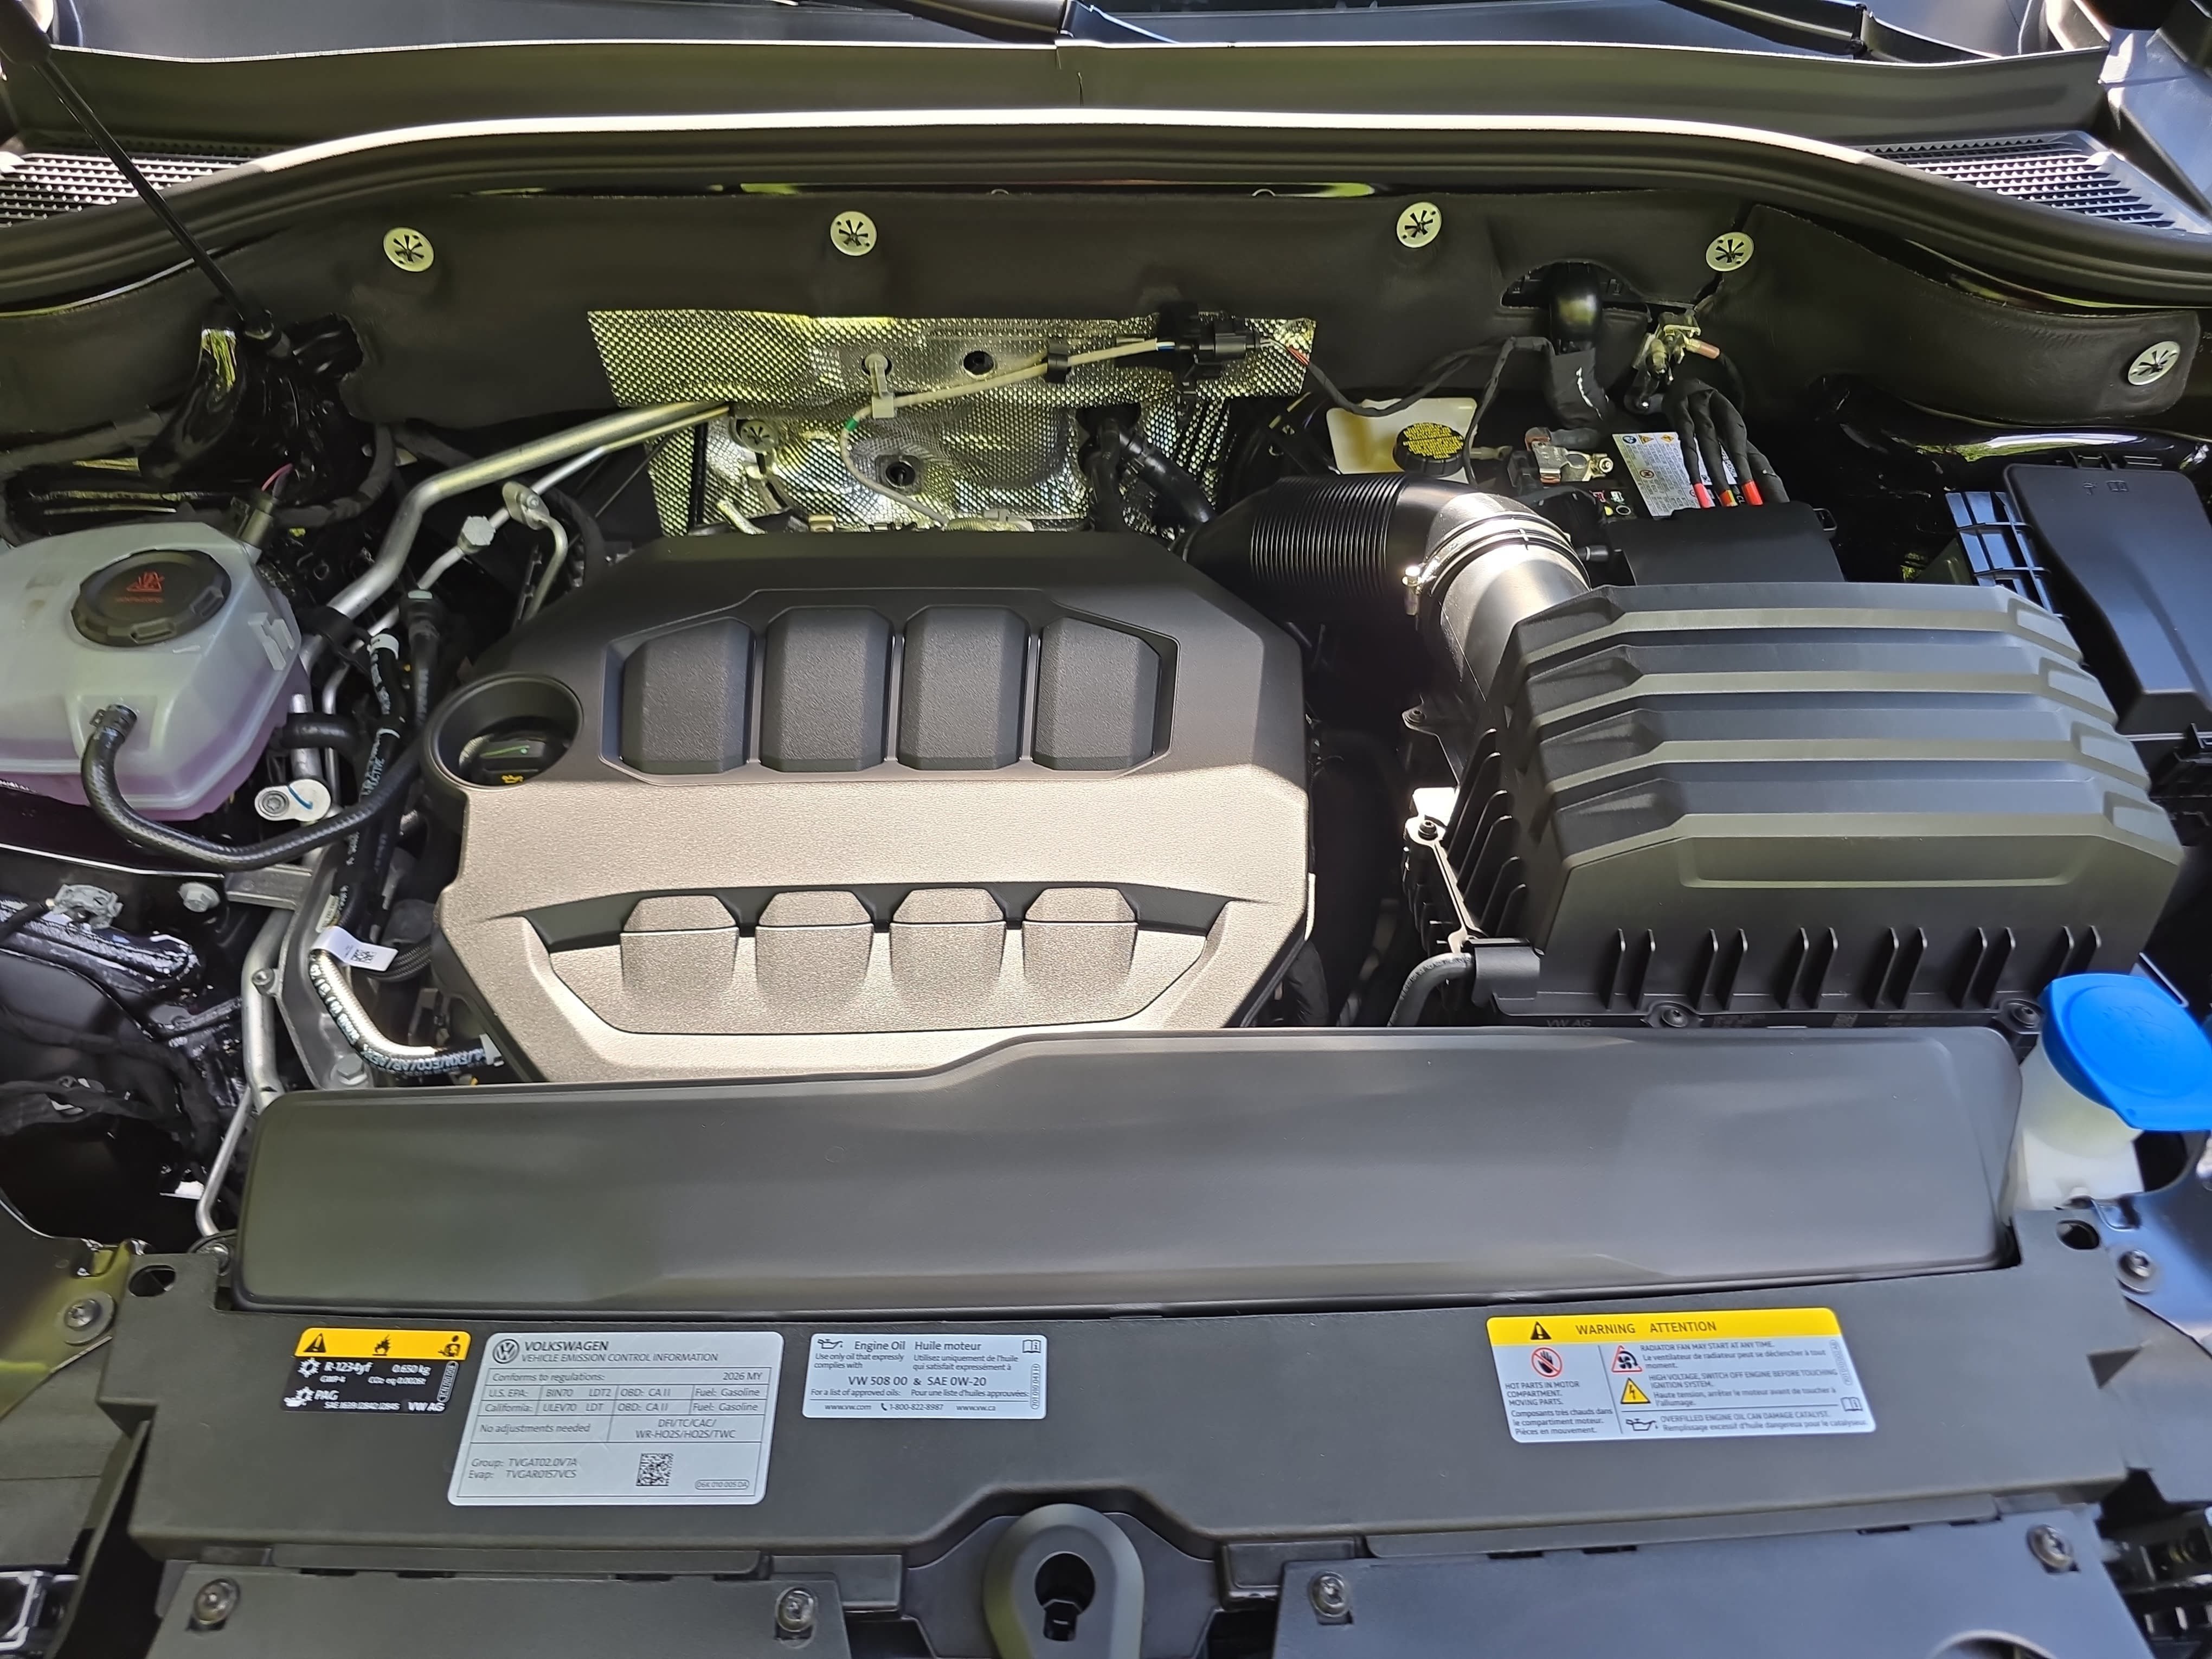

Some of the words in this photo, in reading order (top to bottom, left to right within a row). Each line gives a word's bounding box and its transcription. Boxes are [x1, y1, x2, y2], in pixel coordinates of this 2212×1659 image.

[1576, 1324, 1636, 1335] WARNING
[1650, 1321, 1717, 1333] ATTENTION
[524, 1341, 609, 1351] VOLKSWAGEN
[854, 1341, 889, 1352] Engine
[891, 1341, 906, 1350] Oil
[915, 1341, 942, 1350] Huile
[522, 1354, 559, 1362] VEHICLE
[561, 1354, 605, 1362] EMISSION
[607, 1353, 651, 1361] CONTROL
[653, 1353, 718, 1361] INFORMATION
[829, 1353, 844, 1361] only
[872, 1353, 904, 1362] expressly
[941, 1355, 985, 1363] uniquement
[956, 1363, 1005, 1371] expressément
[492, 1373, 537, 1381] Conforms
[551, 1372, 605, 1383] regulations:
[722, 1372, 744, 1380] 2026
[848, 1377, 867, 1385] VW
[870, 1377, 890, 1385] 508
[893, 1377, 908, 1385] 00
[927, 1377, 948, 1385] SAE
[950, 1377, 987, 1386] 0W-20
[314, 1390, 339, 1400] PAG
[588, 1388, 612, 1397] LDT2
[620, 1388, 644, 1397] OBD:
[648, 1388, 661, 1397] CA
[695, 1388, 717, 1396] Fuel:
[721, 1388, 760, 1396] Gasoline
[851, 1389, 885, 1397] approved
[987, 1390, 1030, 1398] approuvées:
[408, 1402, 426, 1411] VW
[426, 1402, 445, 1411] AG
[485, 1404, 533, 1412] California:
[586, 1403, 604, 1411] LDT
[693, 1403, 715, 1411] Fuel:
[719, 1403, 758, 1411] Gasoline
[658, 1419, 717, 1427] DFI/TC/CAC/
[479, 1424, 493, 1432] No
[494, 1424, 554, 1435] adjustments
[555, 1424, 591, 1432] needed
[1662, 1424, 1708, 1432] Remplissage
[471, 1458, 504, 1468] Group:
[468, 1470, 494, 1481] Evap:
